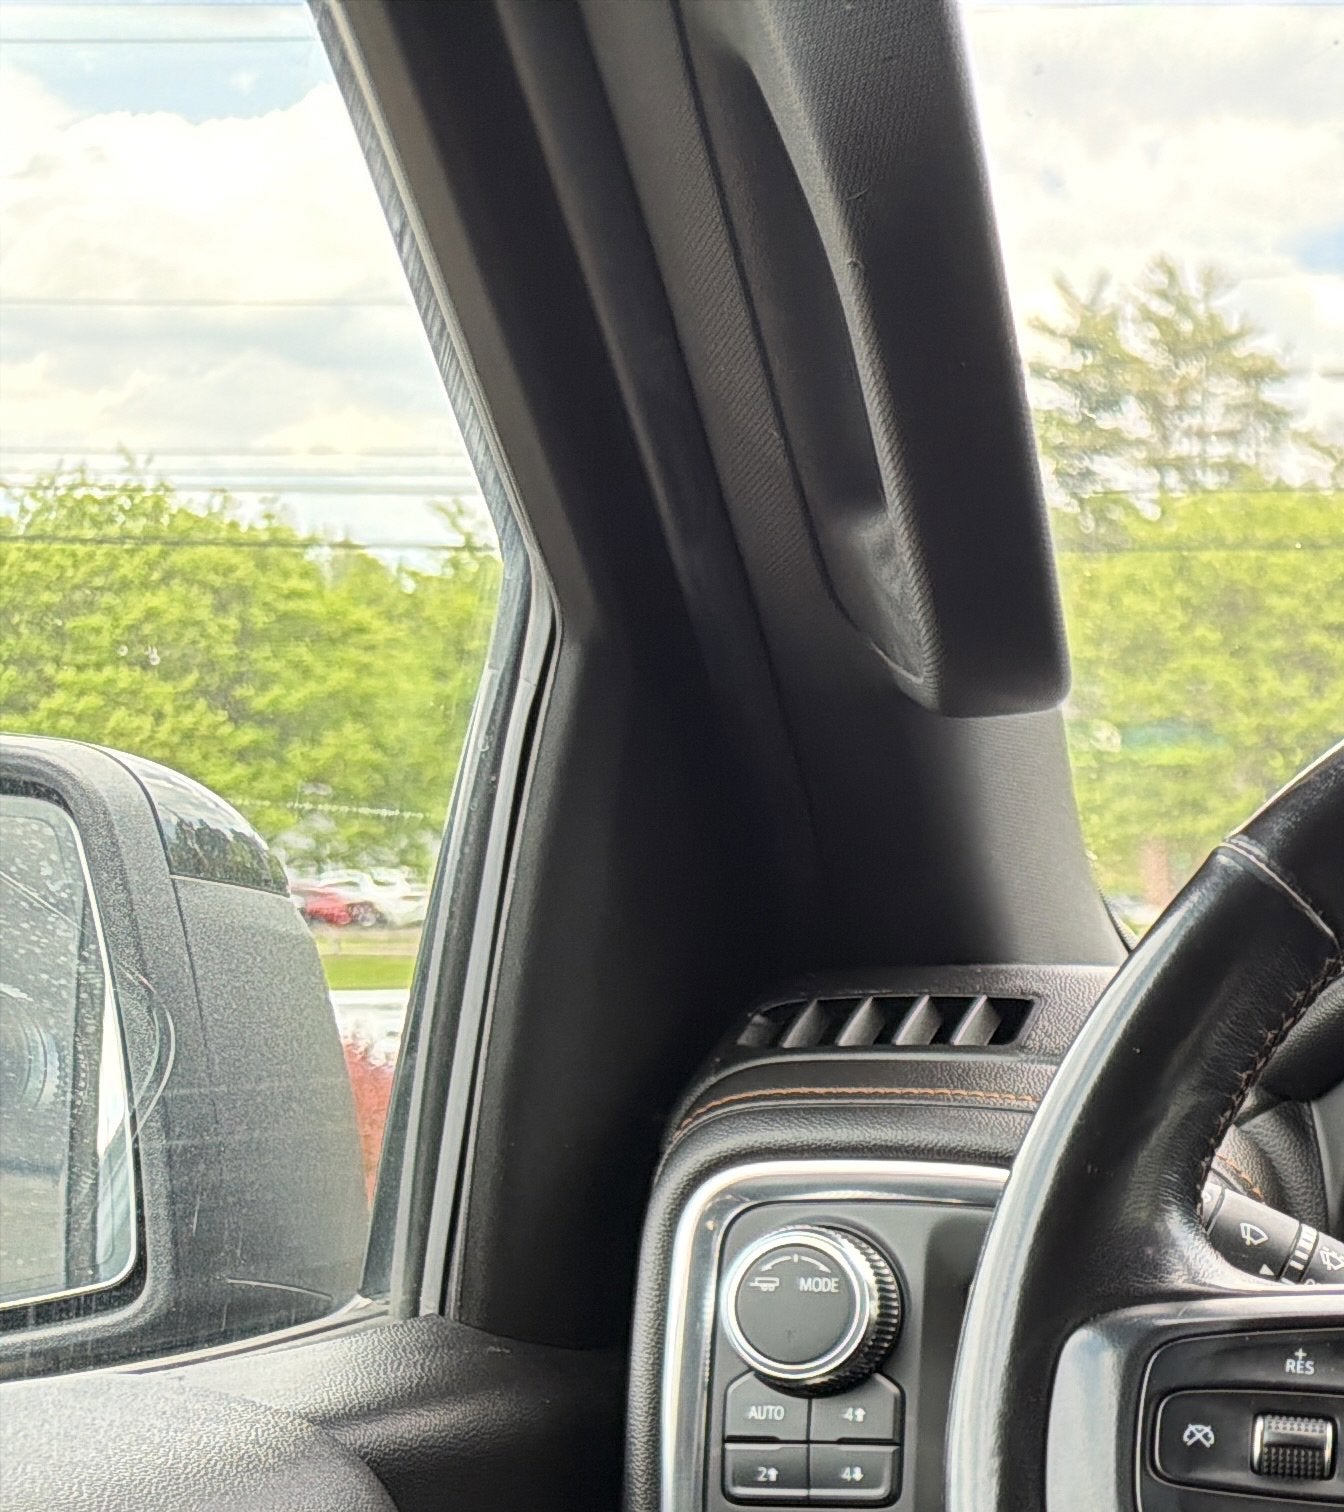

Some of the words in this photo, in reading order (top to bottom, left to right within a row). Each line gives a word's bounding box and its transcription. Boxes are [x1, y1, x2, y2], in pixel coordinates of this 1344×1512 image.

[799, 1277, 840, 1293] MODE
[1285, 1358, 1315, 1376] RES
[748, 1405, 785, 1420] AUTO
